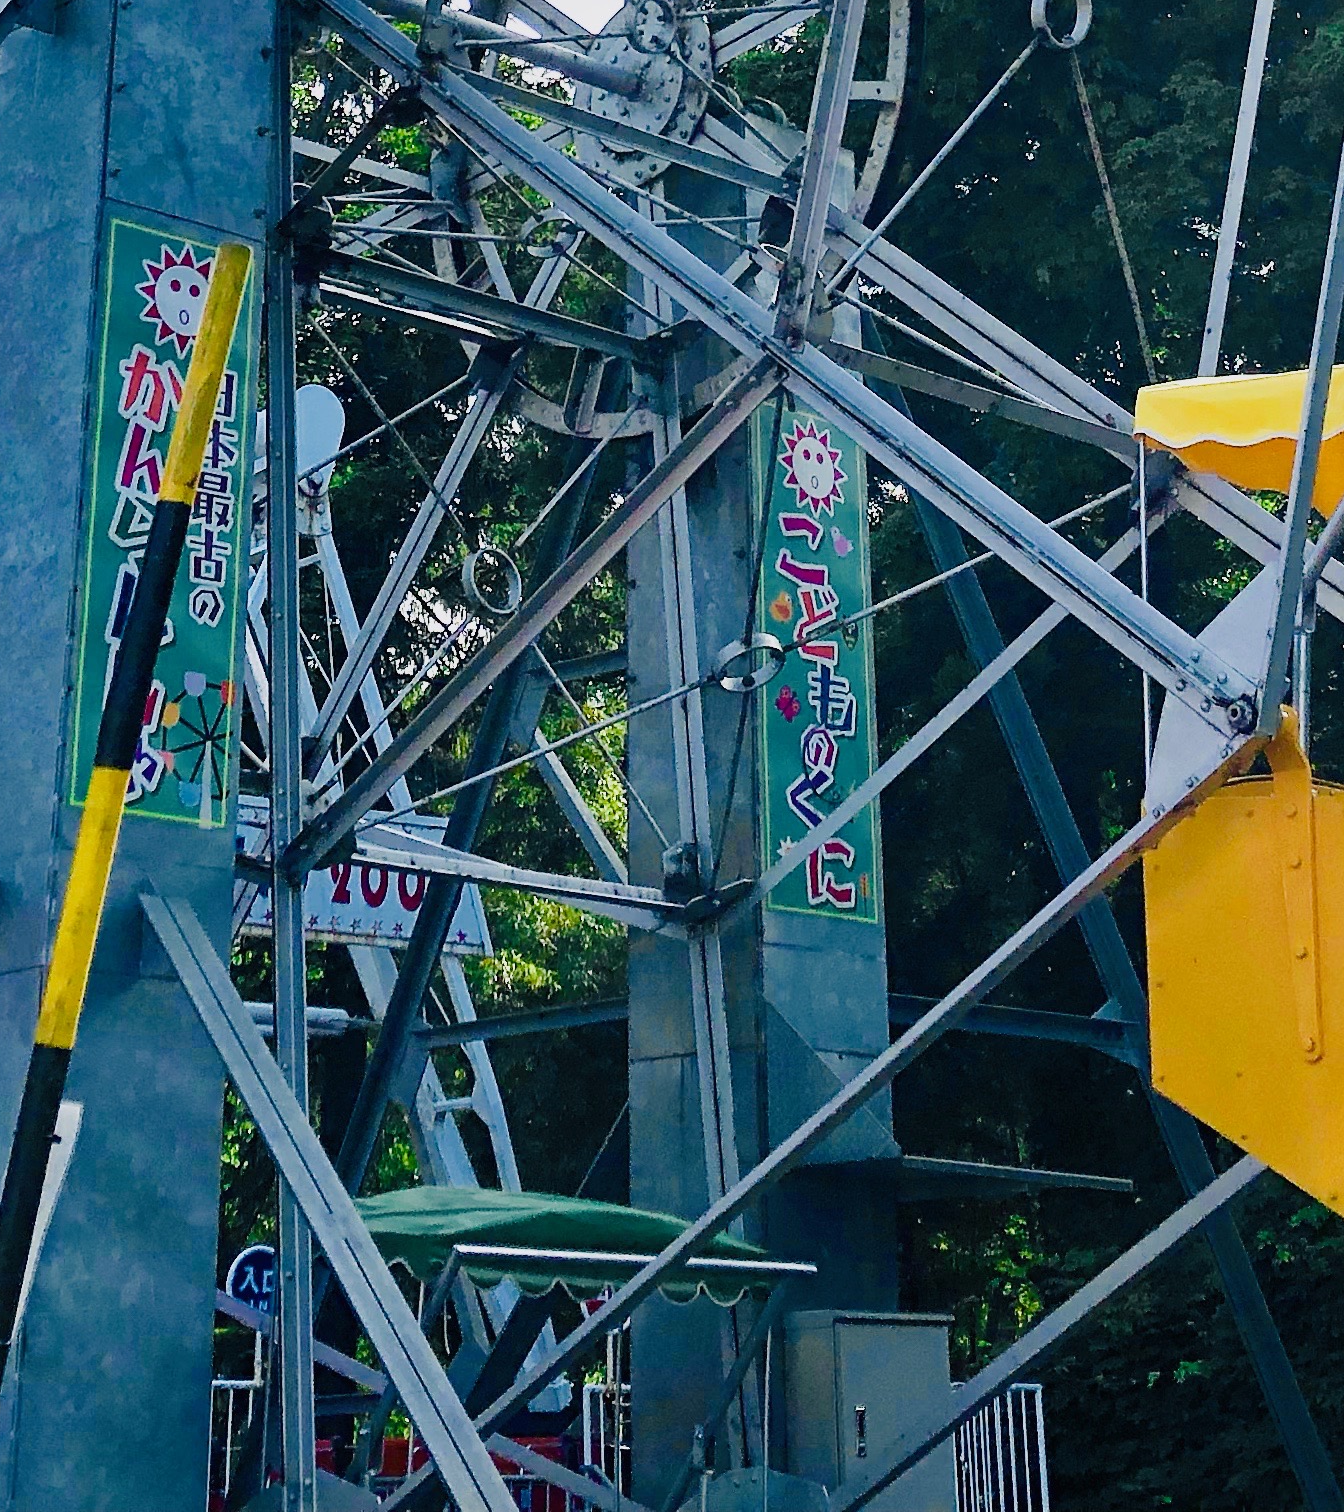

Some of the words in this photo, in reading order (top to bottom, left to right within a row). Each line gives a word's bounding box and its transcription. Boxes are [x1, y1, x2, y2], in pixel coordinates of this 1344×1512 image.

[775, 512, 856, 909] こどものくに
